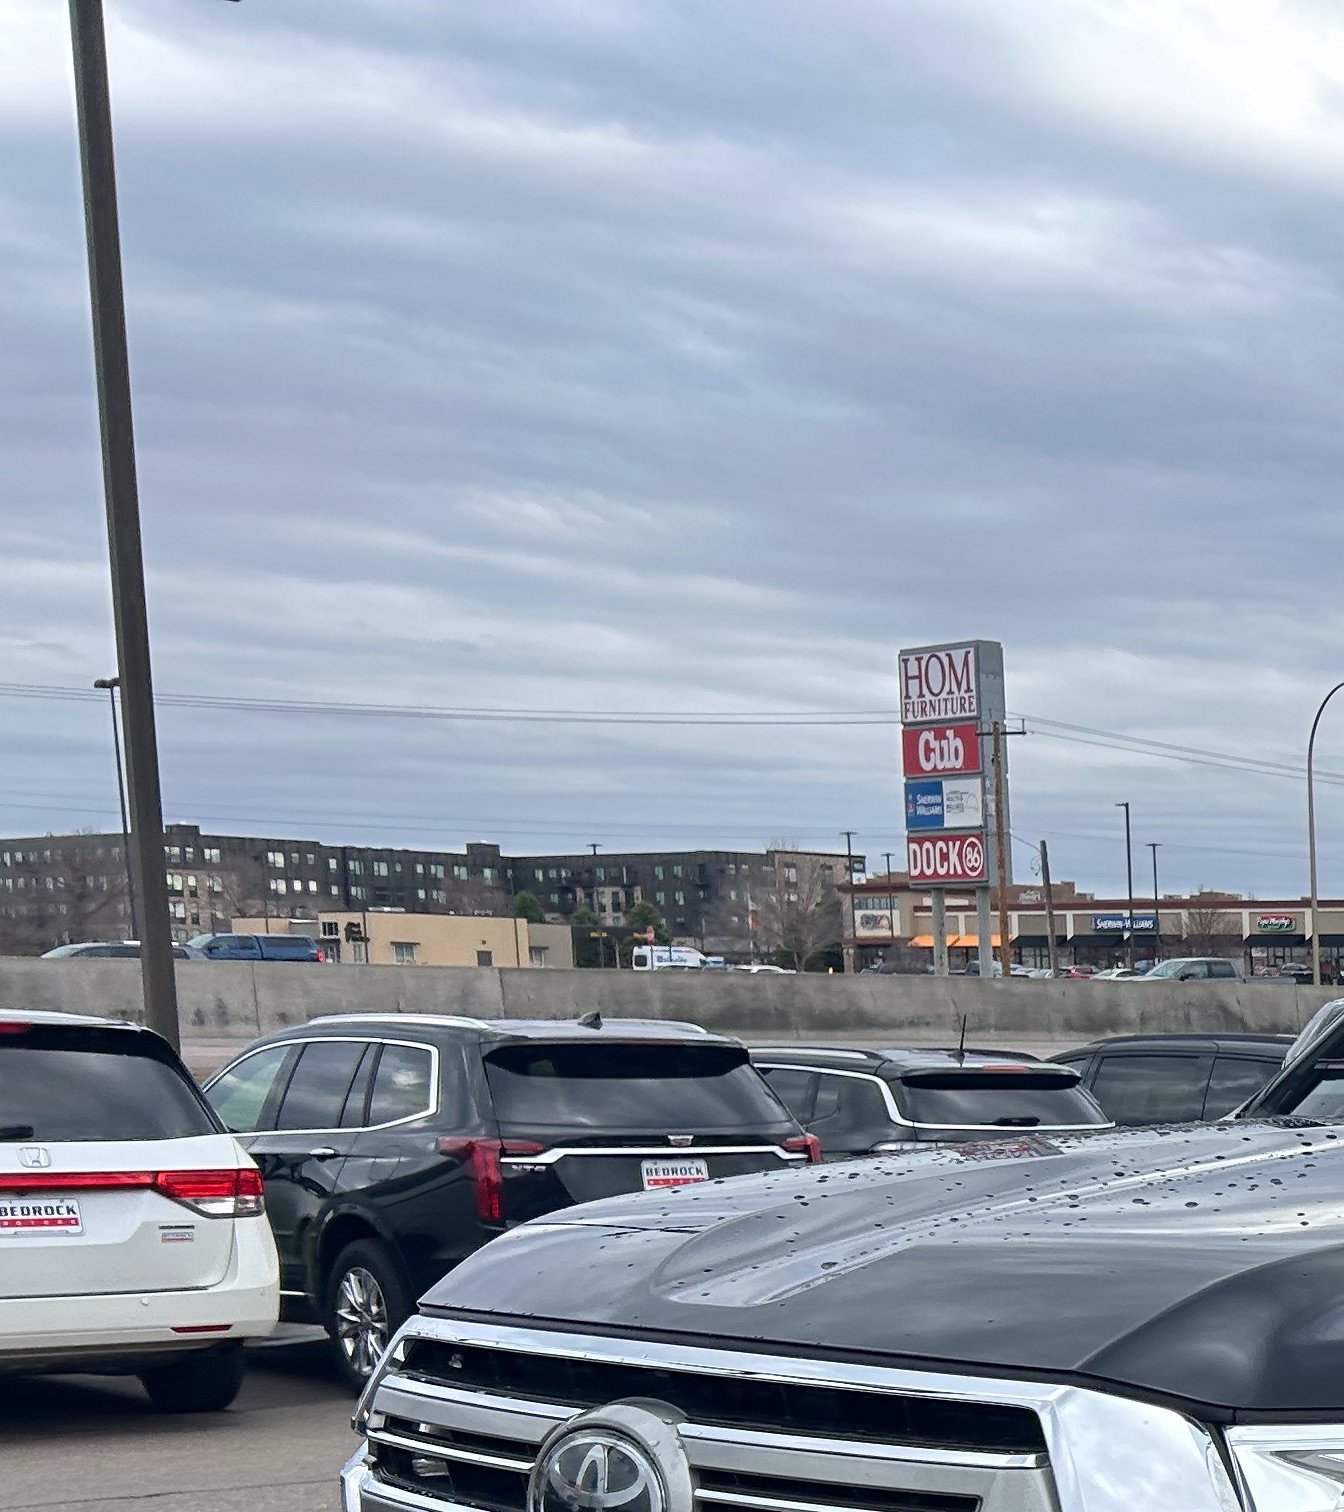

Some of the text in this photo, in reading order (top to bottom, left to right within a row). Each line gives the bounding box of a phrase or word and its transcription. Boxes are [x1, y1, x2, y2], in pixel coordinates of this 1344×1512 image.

[902, 650, 974, 699] HOM
[904, 695, 976, 719] FURNITURE
[918, 729, 965, 771] Cub
[909, 840, 980, 877] DOCK 86
[645, 1166, 704, 1176] BEDROCK
[0, 1205, 77, 1217] BEDROCK
